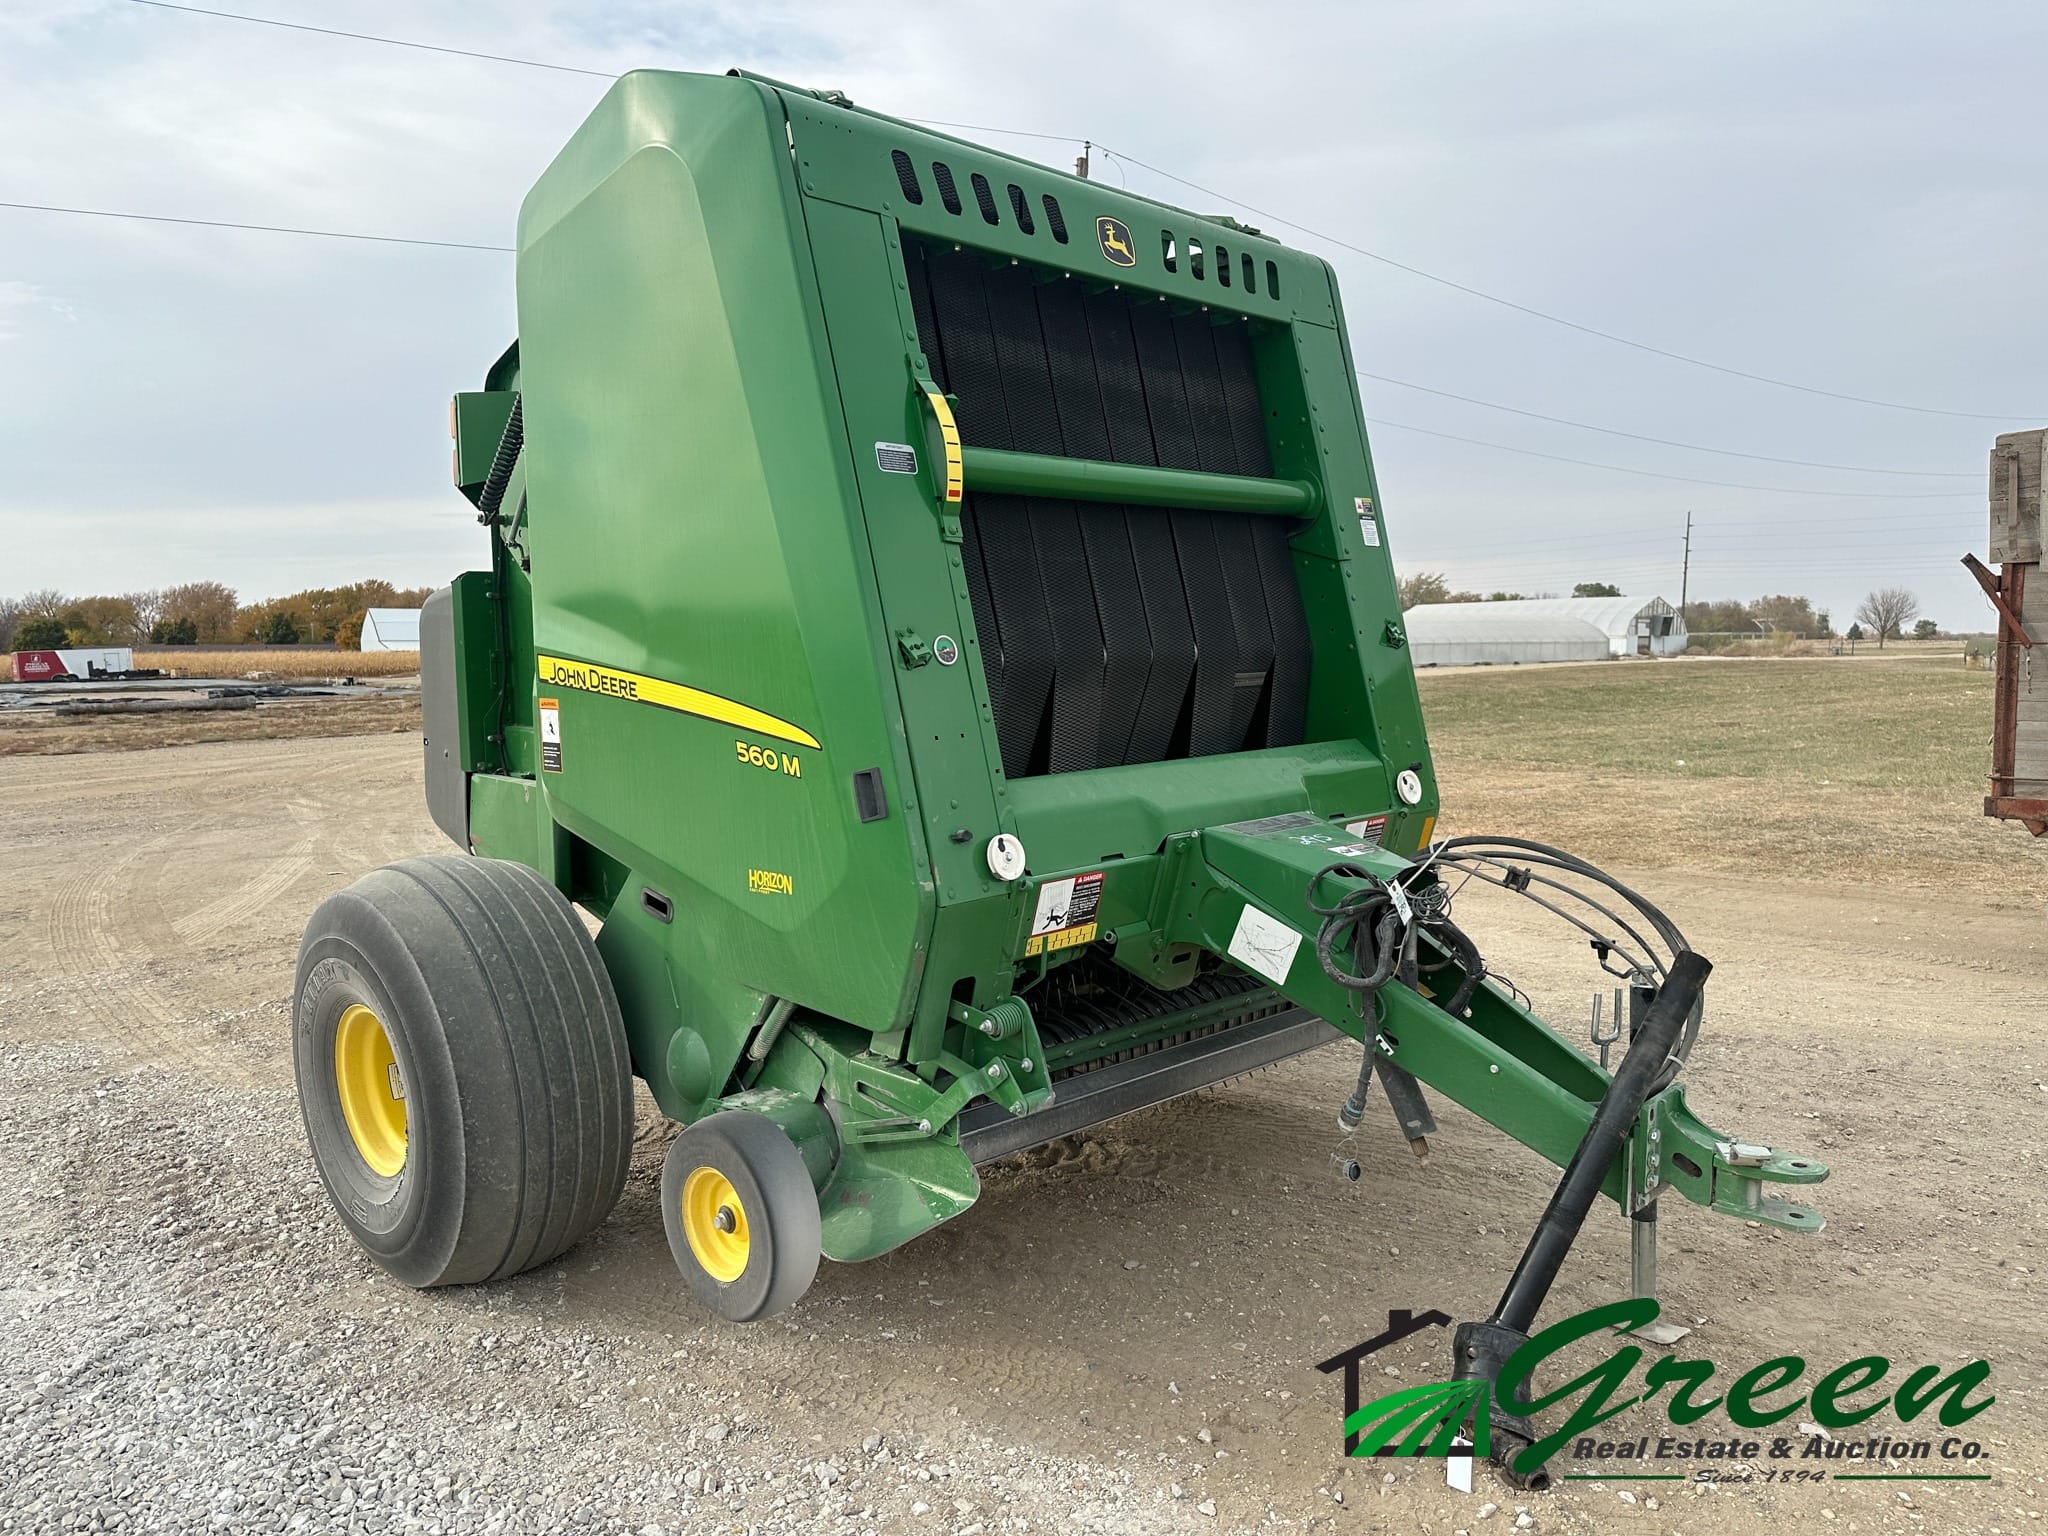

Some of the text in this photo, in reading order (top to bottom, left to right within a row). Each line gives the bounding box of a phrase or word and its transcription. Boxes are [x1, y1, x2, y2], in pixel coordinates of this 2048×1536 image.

[549, 662, 638, 698] JOHN DEERE
[736, 740, 801, 778] 560 M
[749, 869, 792, 895] HORIZON
